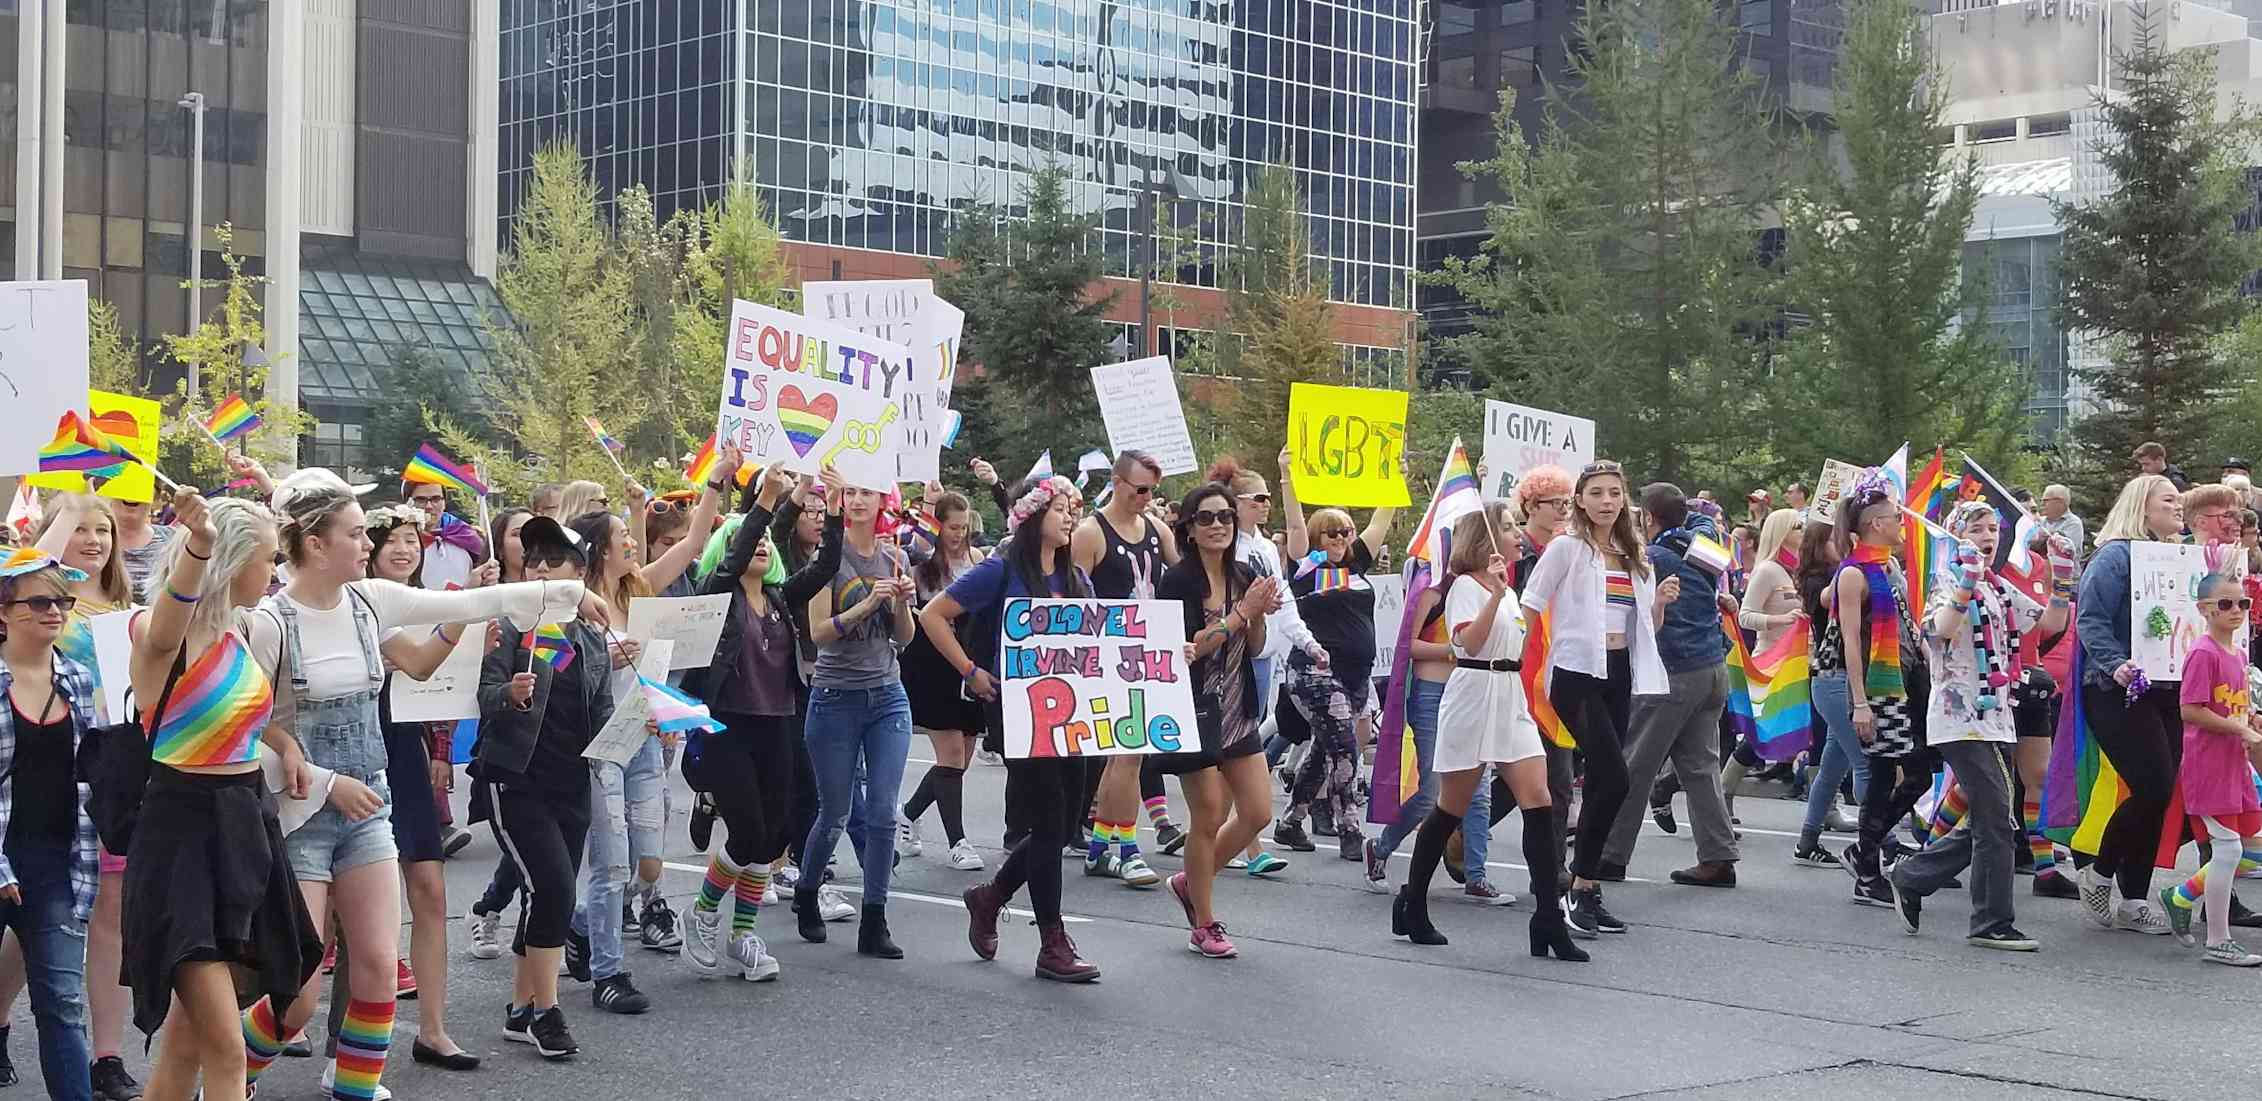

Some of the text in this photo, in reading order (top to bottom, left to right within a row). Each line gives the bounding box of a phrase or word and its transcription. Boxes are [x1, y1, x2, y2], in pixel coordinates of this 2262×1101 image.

[728, 367, 768, 412] IS
[721, 414, 776, 457] KEY
[1491, 408, 1577, 453] I GIVE A
[1003, 598, 1147, 642] COLONEL
[1004, 644, 1104, 681] IRVINE
[1026, 676, 1182, 758] Pride
